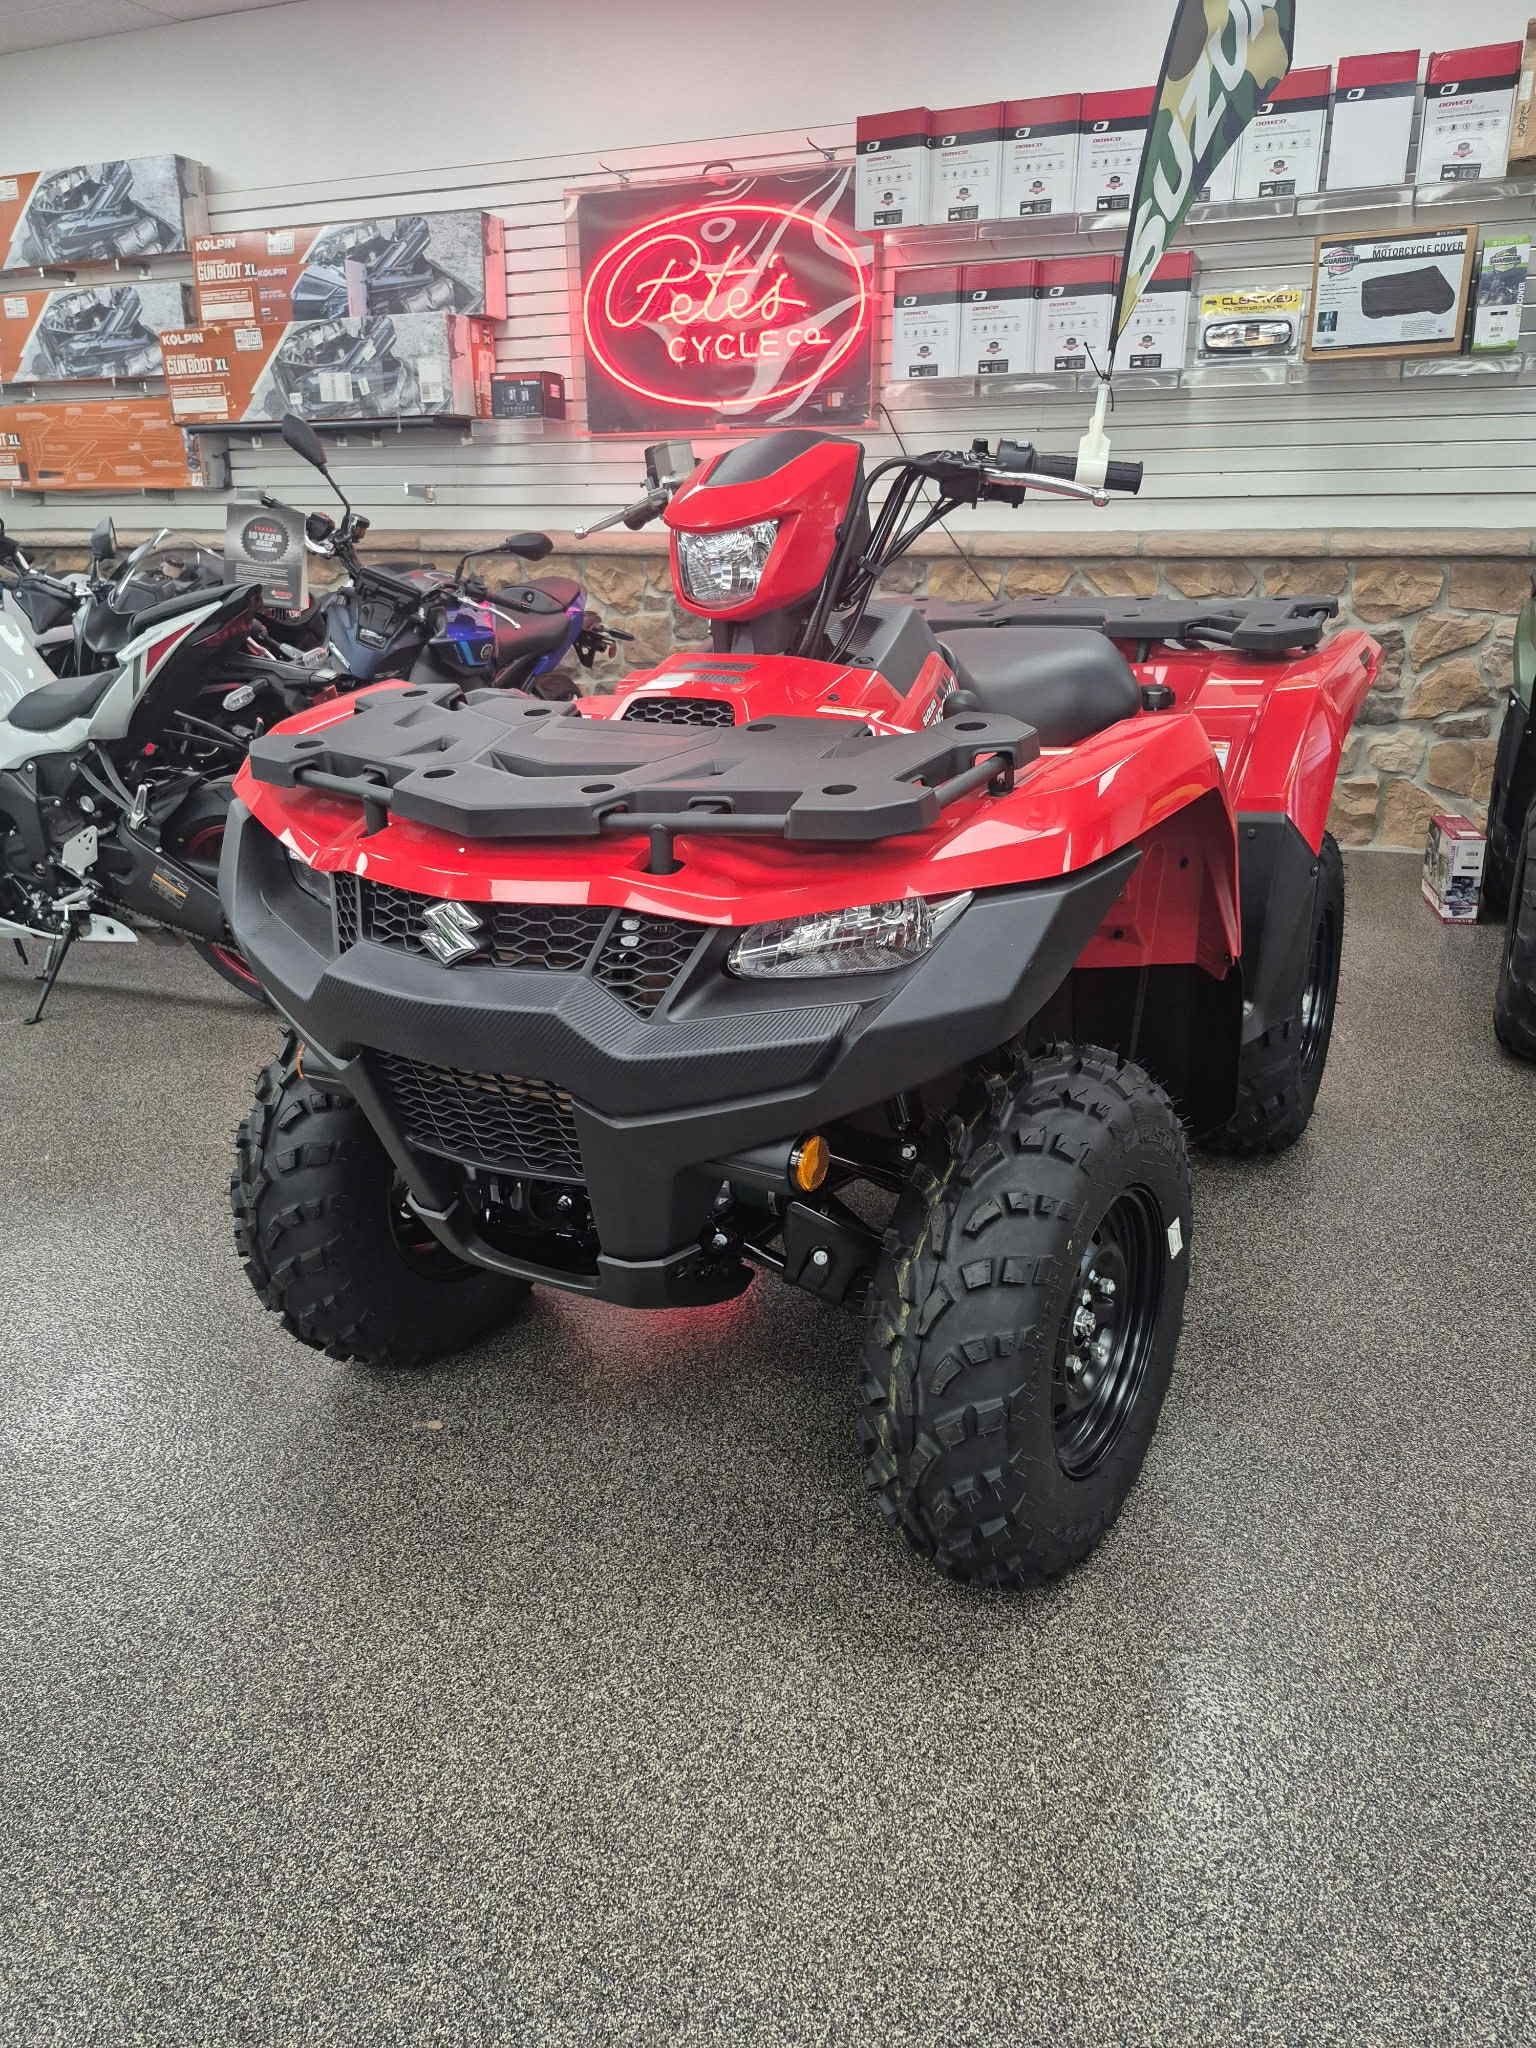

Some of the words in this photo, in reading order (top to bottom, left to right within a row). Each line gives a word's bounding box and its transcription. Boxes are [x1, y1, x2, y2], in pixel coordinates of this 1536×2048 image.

[195, 239, 236, 251] KOLPIN
[1372, 244, 1432, 260] MOTORCYCLE
[1433, 240, 1464, 253] COVER
[1323, 254, 1360, 266] GUARDIAN
[244, 263, 258, 276] XL
[605, 235, 807, 328] Pete's
[161, 332, 205, 345] KOLPIN
[667, 330, 781, 363] CYCLE
[215, 357, 230, 371] XL
[258, 531, 283, 543] YEAR
